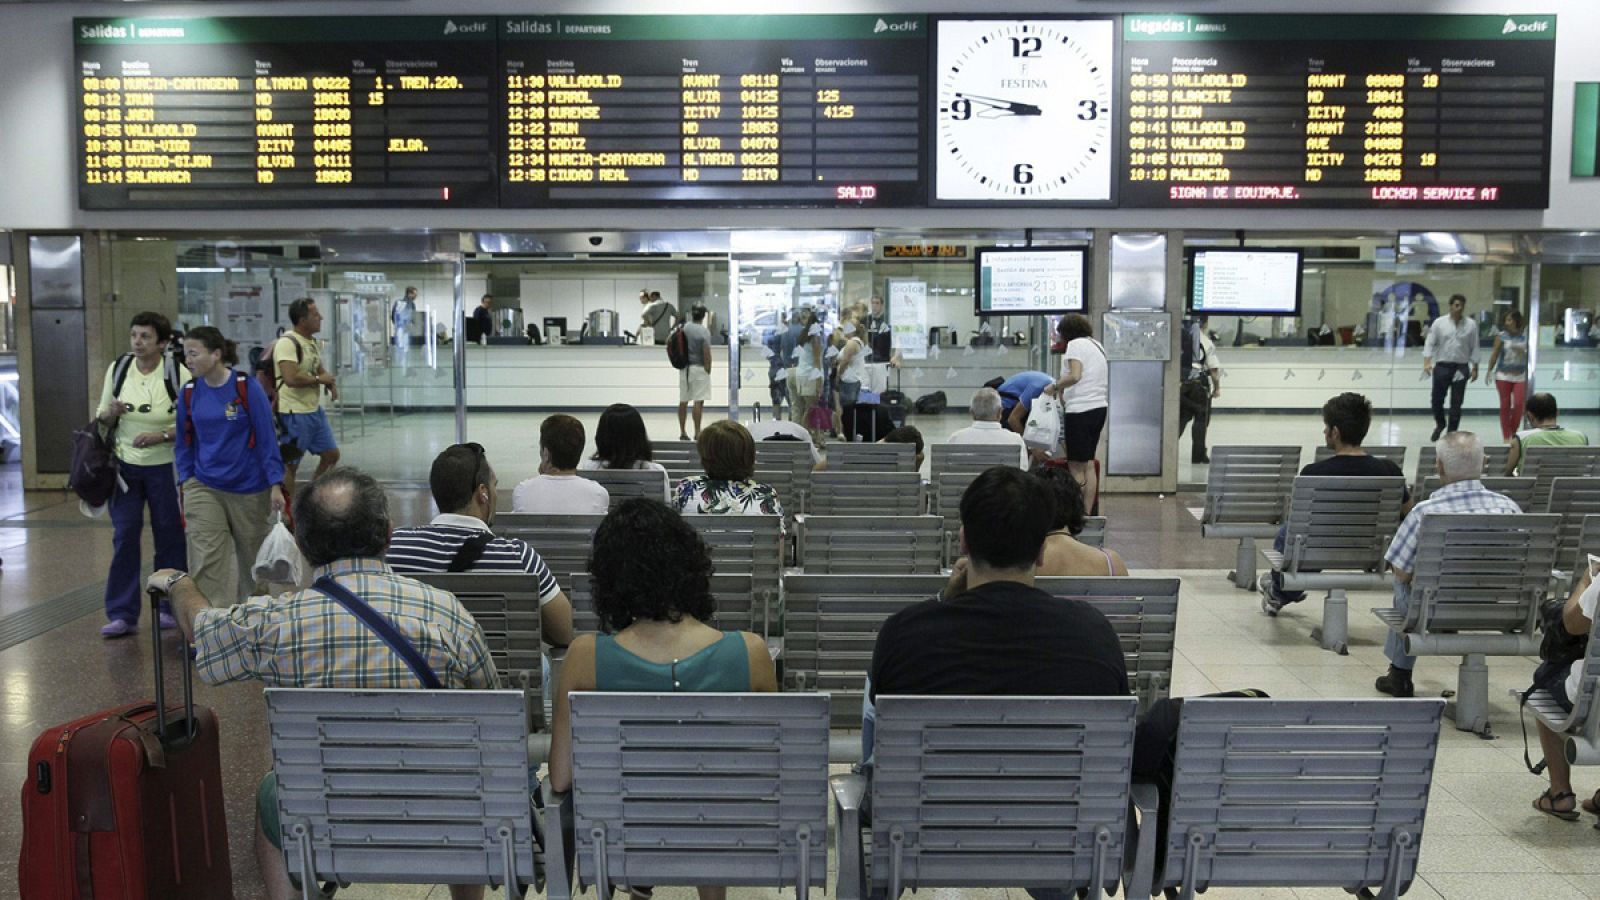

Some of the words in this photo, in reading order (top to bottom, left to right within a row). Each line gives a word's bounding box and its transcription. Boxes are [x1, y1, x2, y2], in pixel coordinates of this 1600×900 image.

[80, 25, 127, 38] Salidas
[460, 22, 488, 33] adif
[506, 20, 552, 33] Salidas
[565, 25, 611, 33] DEPARTURES
[890, 20, 918, 31] adif
[1130, 19, 1185, 35] Llegadas
[1195, 24, 1226, 32] ARRIVALS
[1518, 21, 1548, 32] adif
[1008, 37, 1042, 58] 12
[385, 59, 437, 68] Observaciones
[682, 58, 698, 66] Tren
[815, 58, 868, 66] Observaciones
[1172, 57, 1217, 66] Procedencia
[1441, 59, 1495, 67] Observaciones
[376, 77, 383, 89] 1
[548, 75, 621, 88] VALLADOLID
[683, 75, 720, 87] AVANT
[1000, 79, 1048, 89] FESTINA
[1171, 74, 1247, 88] VALLADOLID
[1308, 75, 1345, 87] AVANT
[256, 93, 272, 106] MD
[369, 92, 383, 104] 15
[683, 90, 720, 103] ALVIA
[740, 90, 778, 103] 04125
[817, 90, 839, 102] 125
[1170, 90, 1231, 103] ALBACETE
[1308, 91, 1324, 103] MD
[256, 108, 272, 121] MD
[548, 107, 600, 119] OURENSE
[684, 106, 720, 118] ICITY
[824, 106, 854, 118] 4125
[951, 99, 972, 121] 9
[1077, 100, 1098, 121] 3
[1170, 105, 1203, 118] LEON
[1308, 107, 1345, 118] ICITY
[124, 124, 196, 136] VALLADOLID
[257, 124, 293, 136] AVANT
[509, 123, 544, 134] 12:22
[549, 122, 579, 134] IRUN
[683, 122, 699, 134] MD
[1171, 121, 1245, 134] VALLADOLID
[1307, 122, 1344, 134] AVANT
[125, 140, 190, 152] LEON-VIGO
[258, 140, 294, 152] ICITY
[509, 138, 544, 150] 12:32
[549, 138, 586, 150] CADIZ
[683, 137, 720, 149] ALVIA
[1171, 137, 1245, 149] VALLADOLID
[1307, 138, 1329, 149] AVE
[126, 156, 211, 167] OVIEDO-GIJON
[257, 155, 294, 167] ALVIA
[509, 154, 544, 166] 12:34
[683, 153, 735, 165] ALTARIA
[1170, 153, 1223, 165] VITORIA
[1308, 153, 1344, 165] ICITY
[87, 171, 122, 182] 11:14
[126, 171, 190, 183] SALAMANCA
[258, 171, 273, 183] MD
[549, 169, 593, 181] CIUDAD
[599, 169, 629, 181] REAL
[683, 168, 700, 181] MD
[1013, 163, 1034, 184] 6
[1170, 168, 1230, 181] PALENCIA
[1306, 169, 1321, 181] MD
[1213, 187, 1228, 198] DE
[1235, 187, 1299, 198] EQUIPAJE.
[1372, 188, 1417, 199] LOCKER
[1424, 188, 1475, 199] SERVICE
[1481, 188, 1496, 200] AT
[1033, 279, 1057, 291] 213
[1063, 280, 1078, 291] 04
[1033, 295, 1057, 306] 948
[1063, 295, 1078, 306] 04
